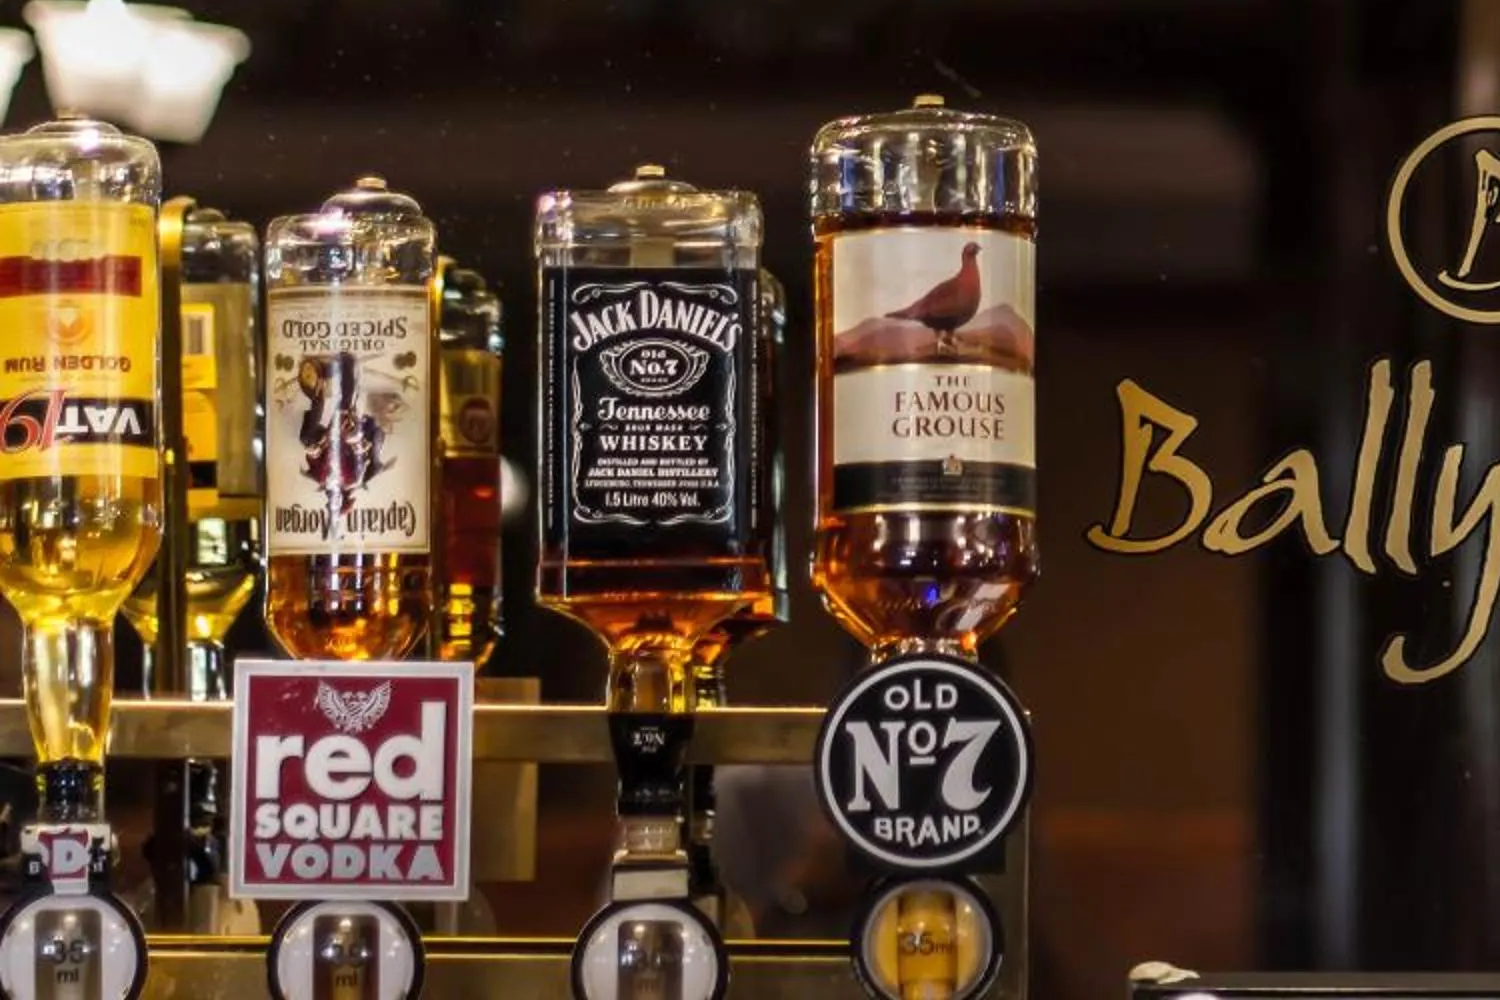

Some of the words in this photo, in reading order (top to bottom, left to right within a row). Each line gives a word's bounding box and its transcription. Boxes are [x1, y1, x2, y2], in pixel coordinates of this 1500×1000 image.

[282, 319, 331, 338] GOLD
[335, 316, 408, 339] SPICED
[570, 300, 637, 351] JACK
[639, 289, 743, 351] DANIEL'S
[4, 356, 46, 373] RUM
[54, 355, 131, 373] GOLDEN
[935, 375, 971, 386] THE
[597, 397, 711, 421] Tennessee
[895, 391, 1005, 415] FAMOUS
[55, 405, 142, 434] VAT
[892, 415, 1005, 440] GROUSE
[600, 435, 708, 451] WHISKEY
[623, 492, 649, 507] Litre
[651, 492, 678, 507] 40%
[347, 500, 416, 540] Captain
[884, 678, 959, 711] OLD
[256, 701, 446, 801] red
[254, 804, 444, 841] SQUARE
[874, 814, 981, 848] BRAND
[256, 844, 445, 880] VODKA
[57, 968, 79, 984] ml
